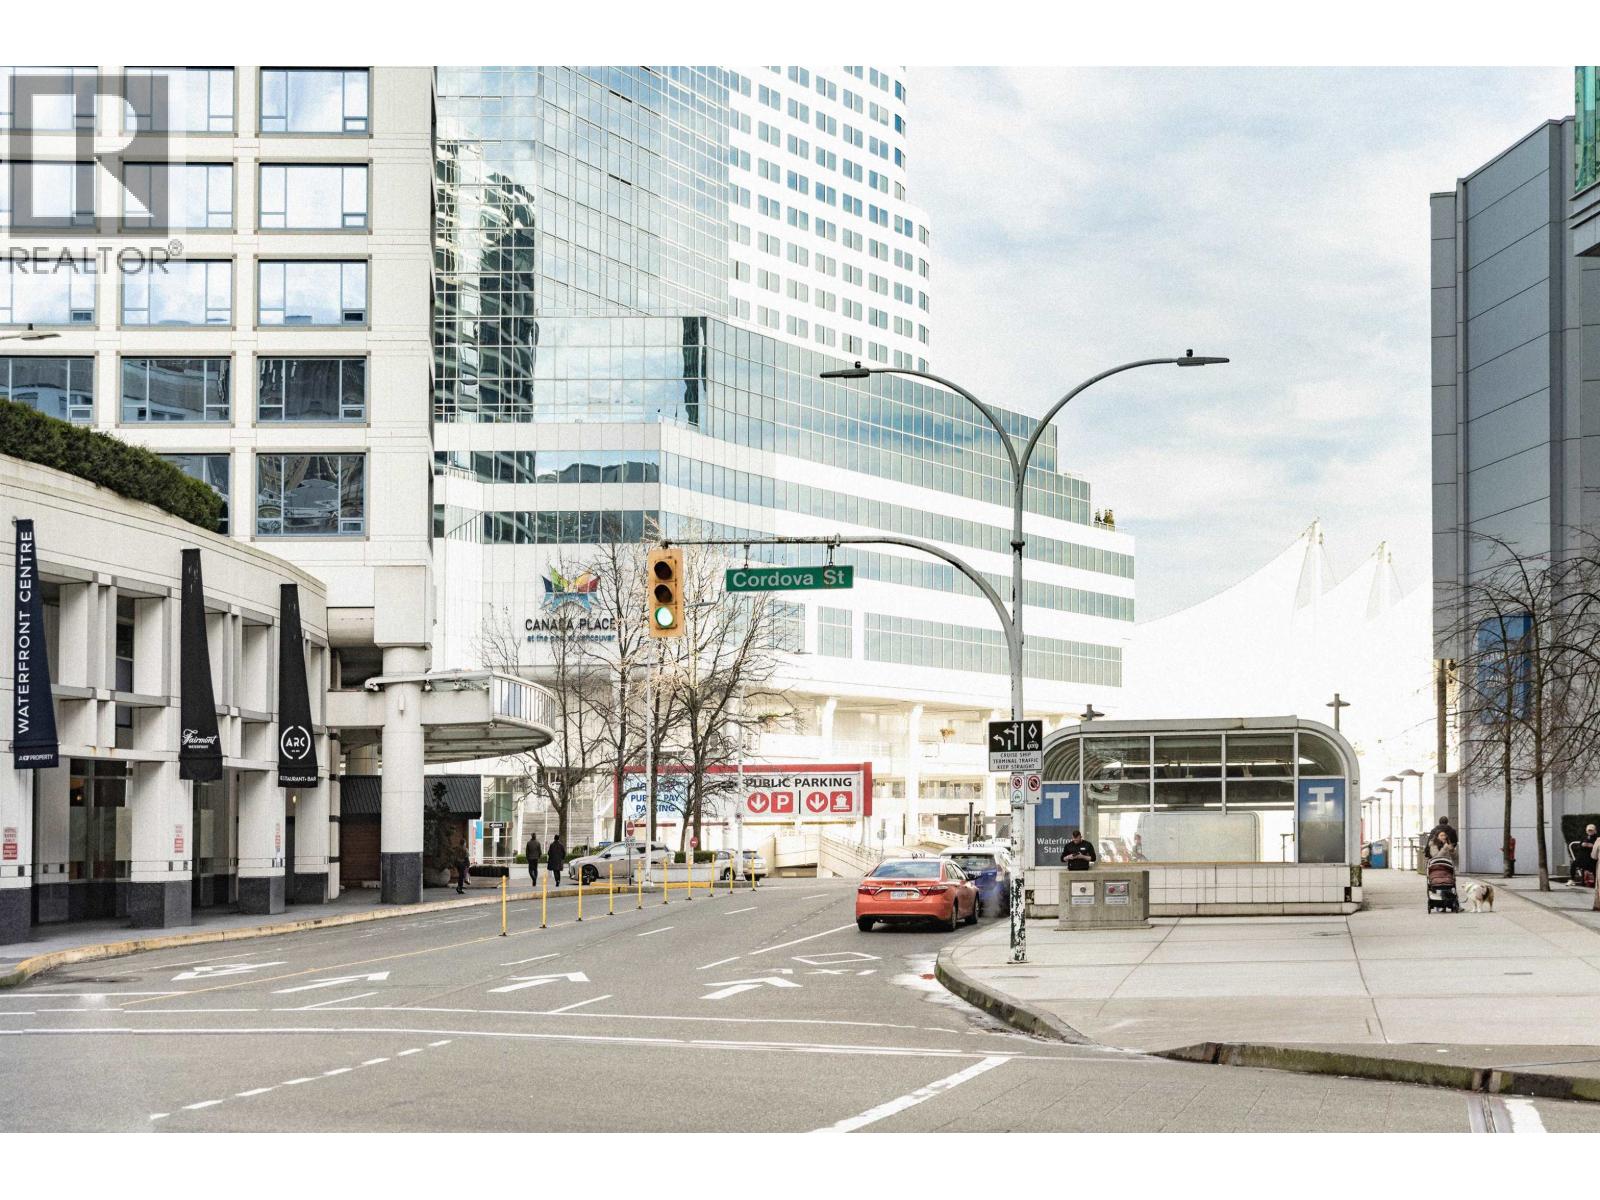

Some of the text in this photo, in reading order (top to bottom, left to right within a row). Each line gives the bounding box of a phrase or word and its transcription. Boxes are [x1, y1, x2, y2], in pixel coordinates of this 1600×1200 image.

[733, 570, 845, 587] Cordova St
[579, 618, 616, 630] PLACE
[18, 531, 33, 734] WATERFRONT CENTRE
[182, 728, 218, 745] Fairmont
[285, 737, 305, 747] ARC
[745, 777, 852, 788] PUBLIC PARKING
[663, 794, 680, 802] PAY
[776, 794, 790, 810] P
[636, 804, 676, 813] PAING
[1045, 792, 1070, 819] T
[1036, 837, 1073, 845] Waterfro
[1043, 846, 1065, 854] Stati
